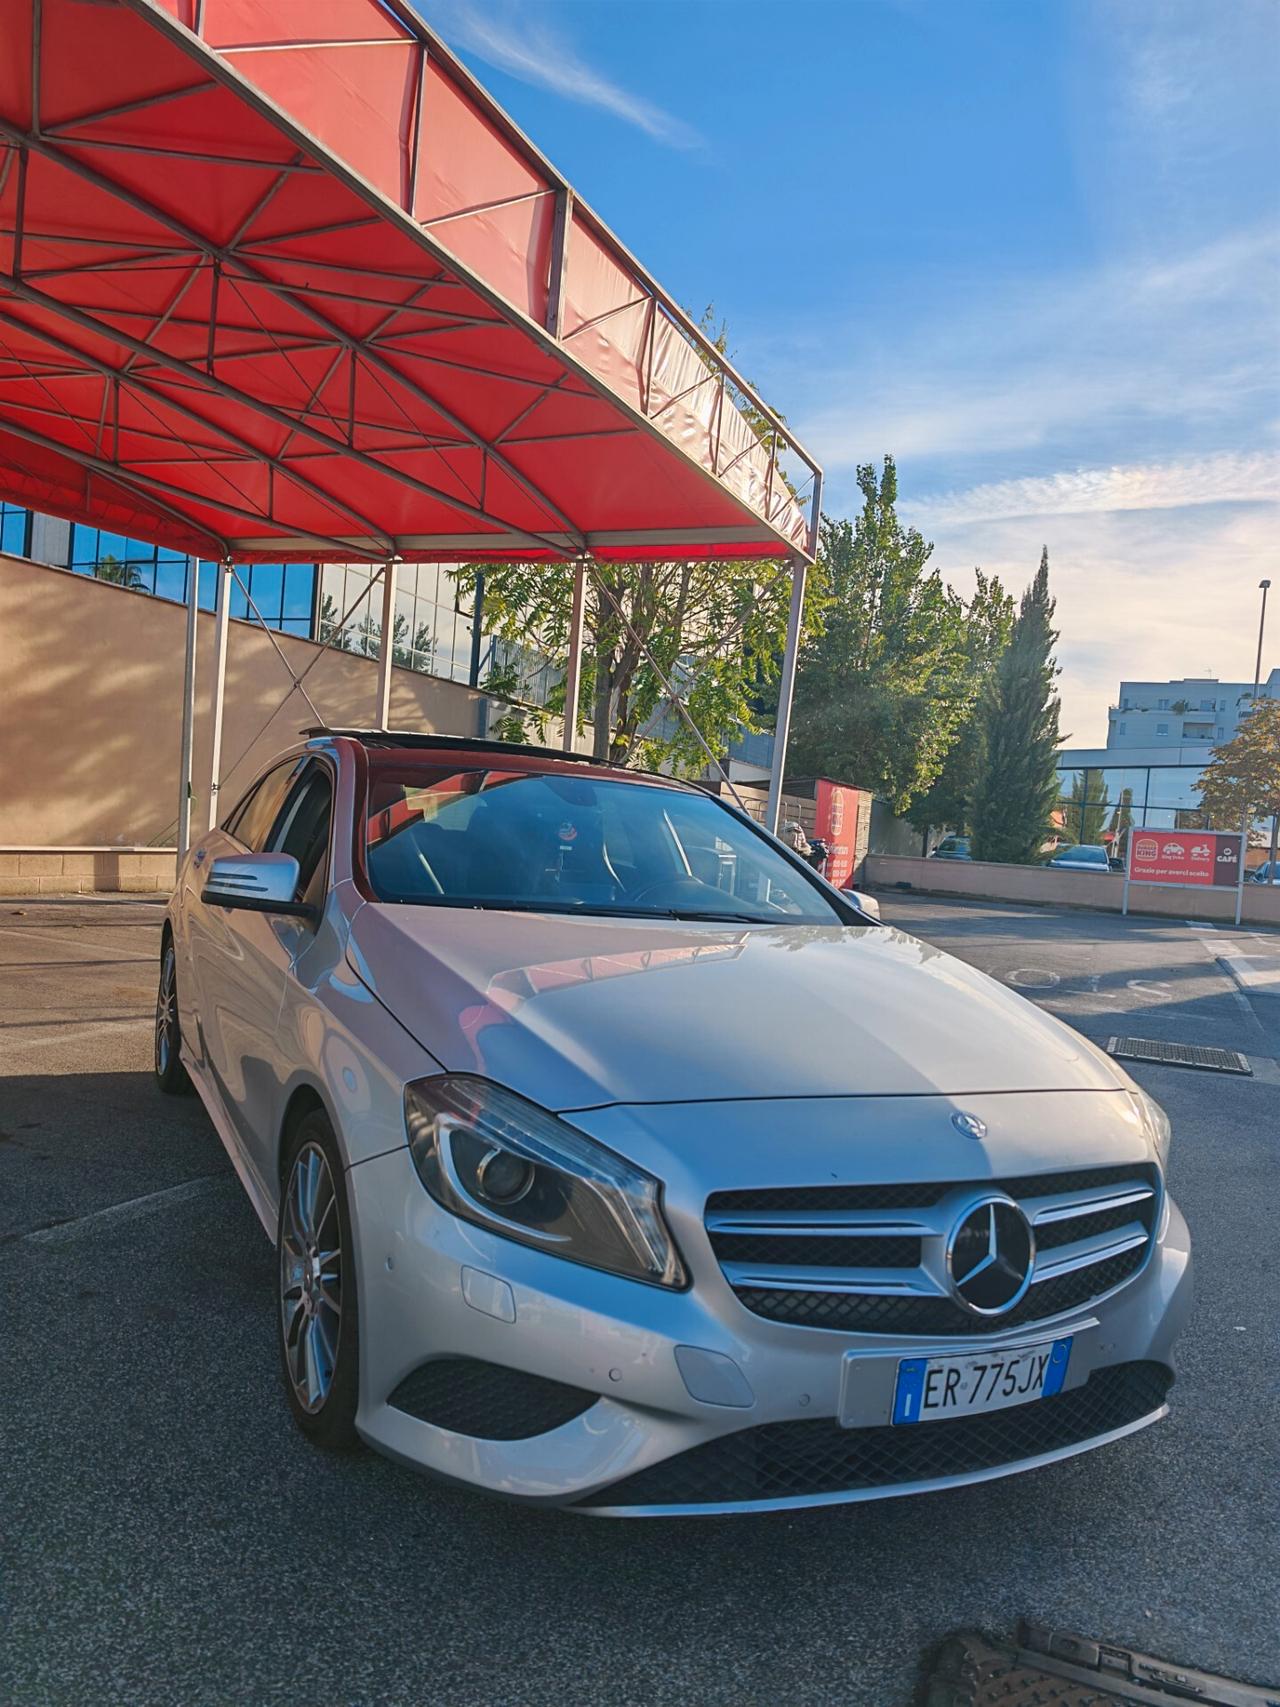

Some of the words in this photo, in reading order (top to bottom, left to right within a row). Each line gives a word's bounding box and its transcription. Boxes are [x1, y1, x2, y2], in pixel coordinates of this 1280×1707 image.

[1217, 855, 1237, 863] CAFÉ
[924, 1369, 960, 1408] ER
[969, 1354, 1049, 1404] 775JX
